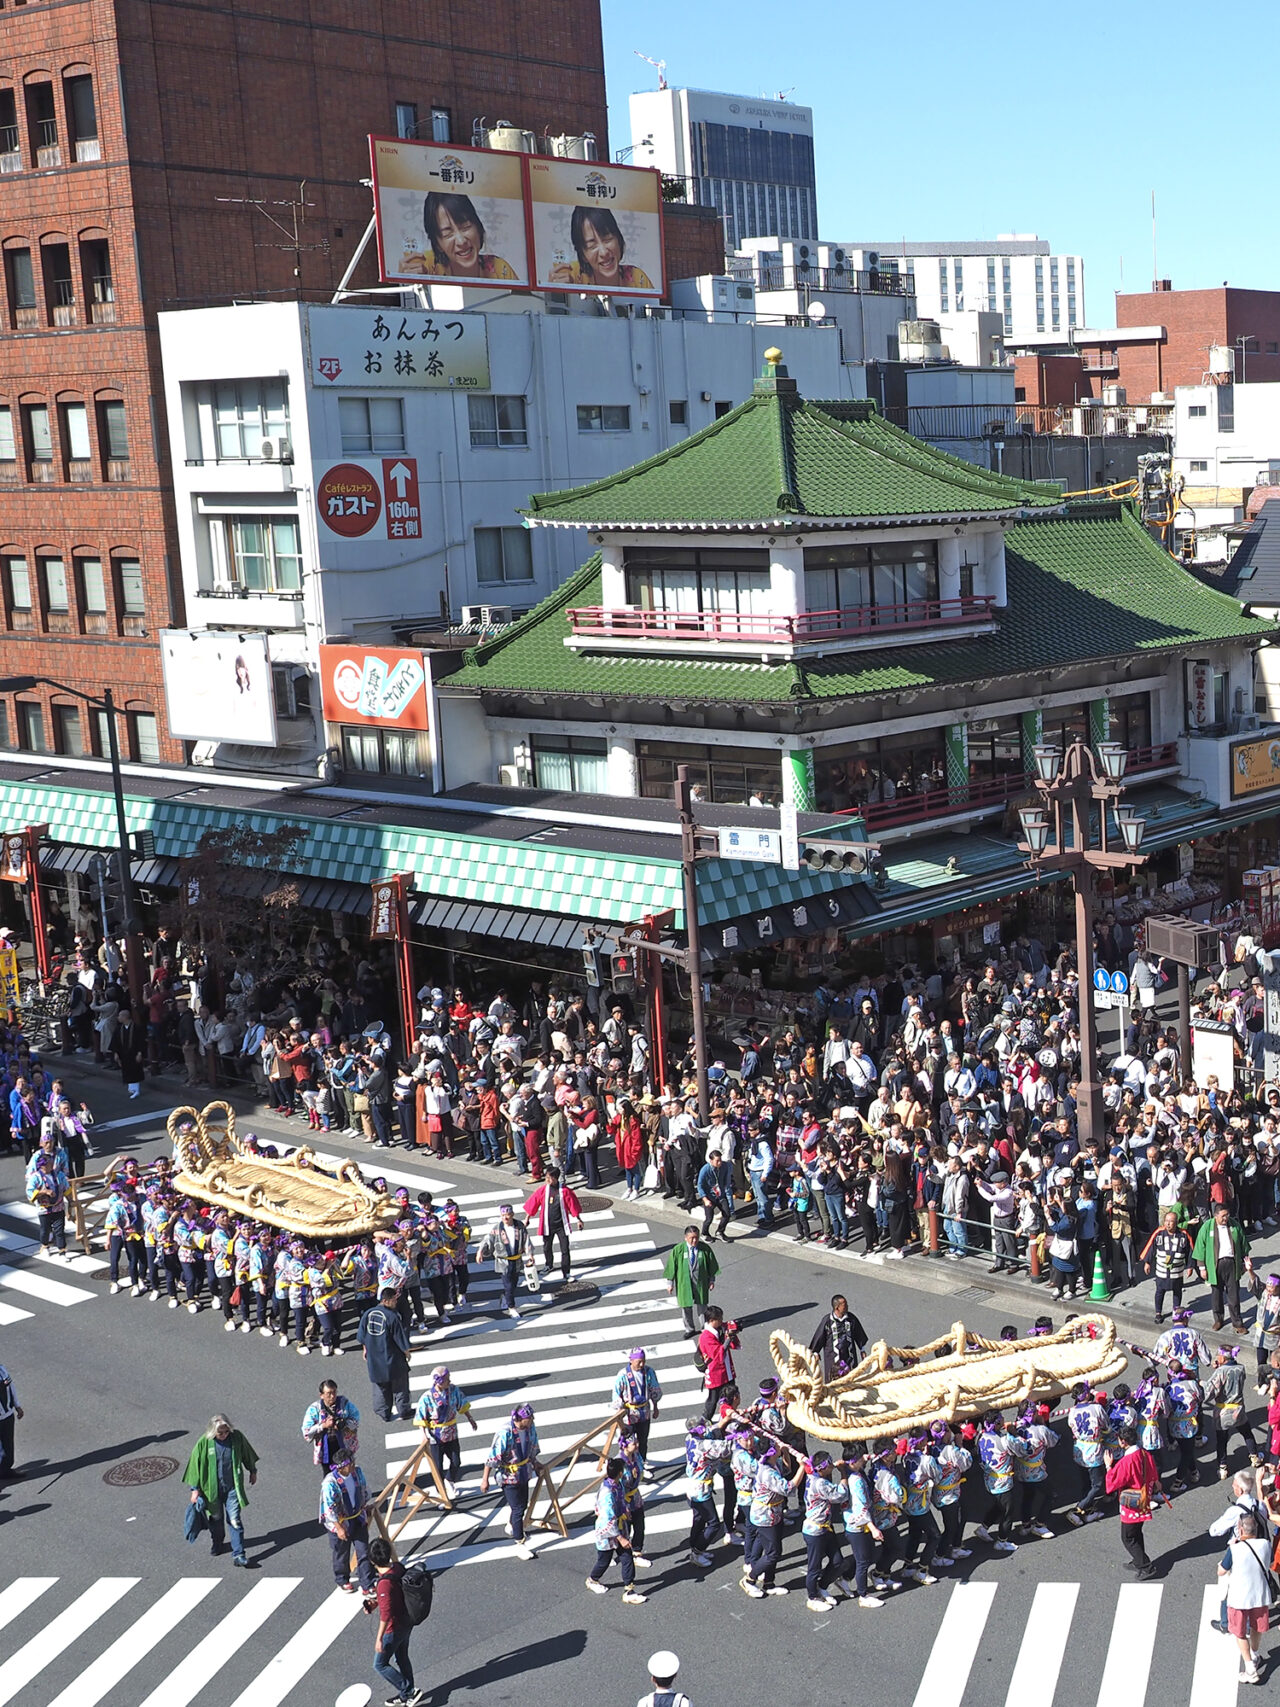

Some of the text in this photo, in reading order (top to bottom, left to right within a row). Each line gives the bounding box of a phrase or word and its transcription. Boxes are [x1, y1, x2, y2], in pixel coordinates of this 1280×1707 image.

[380, 147, 399, 155] KIRIN
[429, 168, 475, 184] 一番搾り
[533, 164, 549, 172] KIRIN
[576, 184, 617, 199] 一番搾り
[372, 314, 464, 342] あんみつ
[320, 360, 340, 374] 2F
[364, 350, 444, 377] お抹茶
[327, 495, 376, 516] ガスト
[388, 501, 418, 519] 160m
[391, 521, 418, 536] 右側
[1195, 677, 1206, 725] 雷おこし
[729, 832, 769, 848] 雷門
